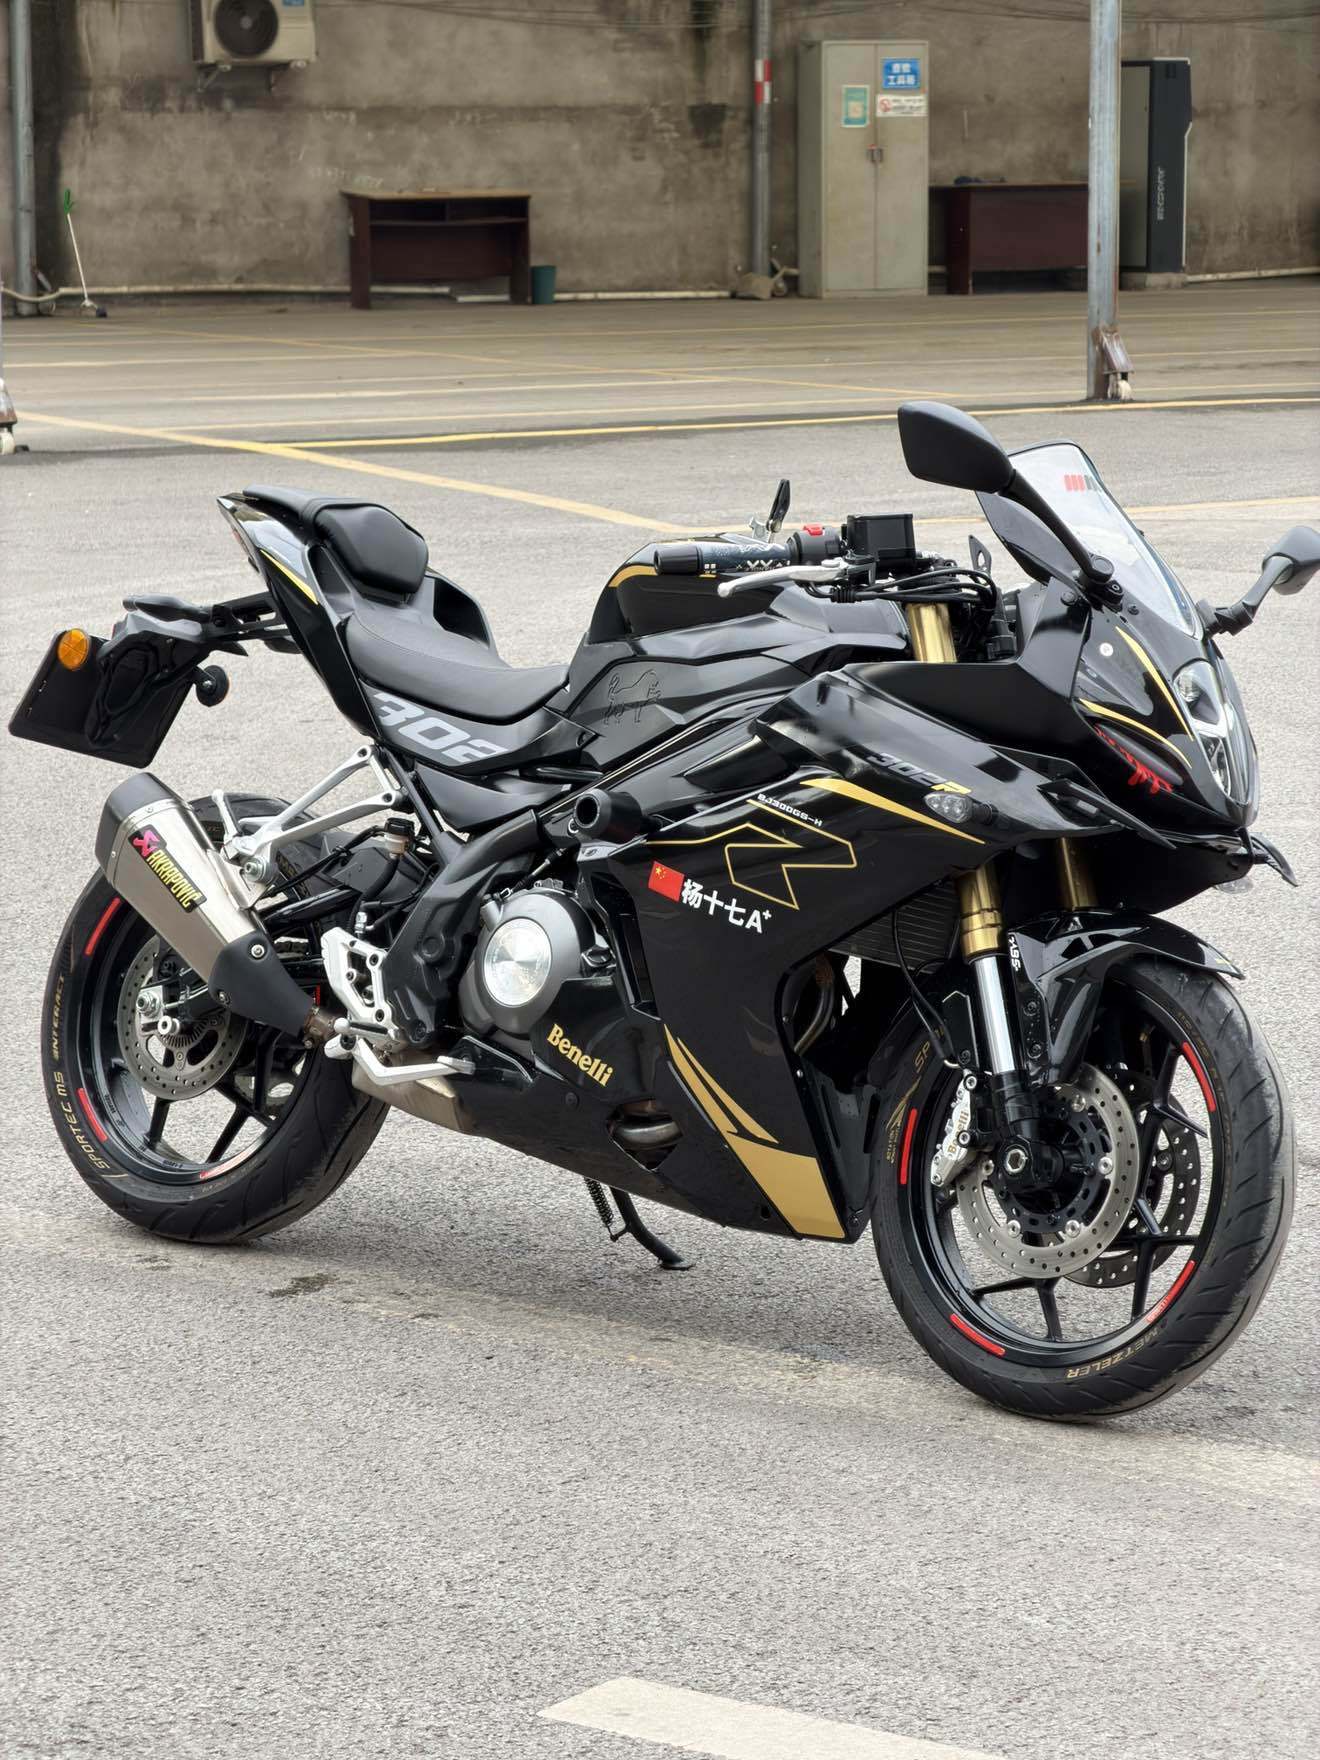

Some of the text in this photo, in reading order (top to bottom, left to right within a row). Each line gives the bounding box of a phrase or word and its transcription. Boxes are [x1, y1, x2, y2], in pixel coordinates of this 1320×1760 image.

[373, 692, 509, 763] 302
[757, 793, 823, 827] BJ300GS-H
[547, 1023, 613, 1086] Benelli
[60, 1101, 110, 1169] SPORTEC
[1066, 1327, 1158, 1378] METZELER
